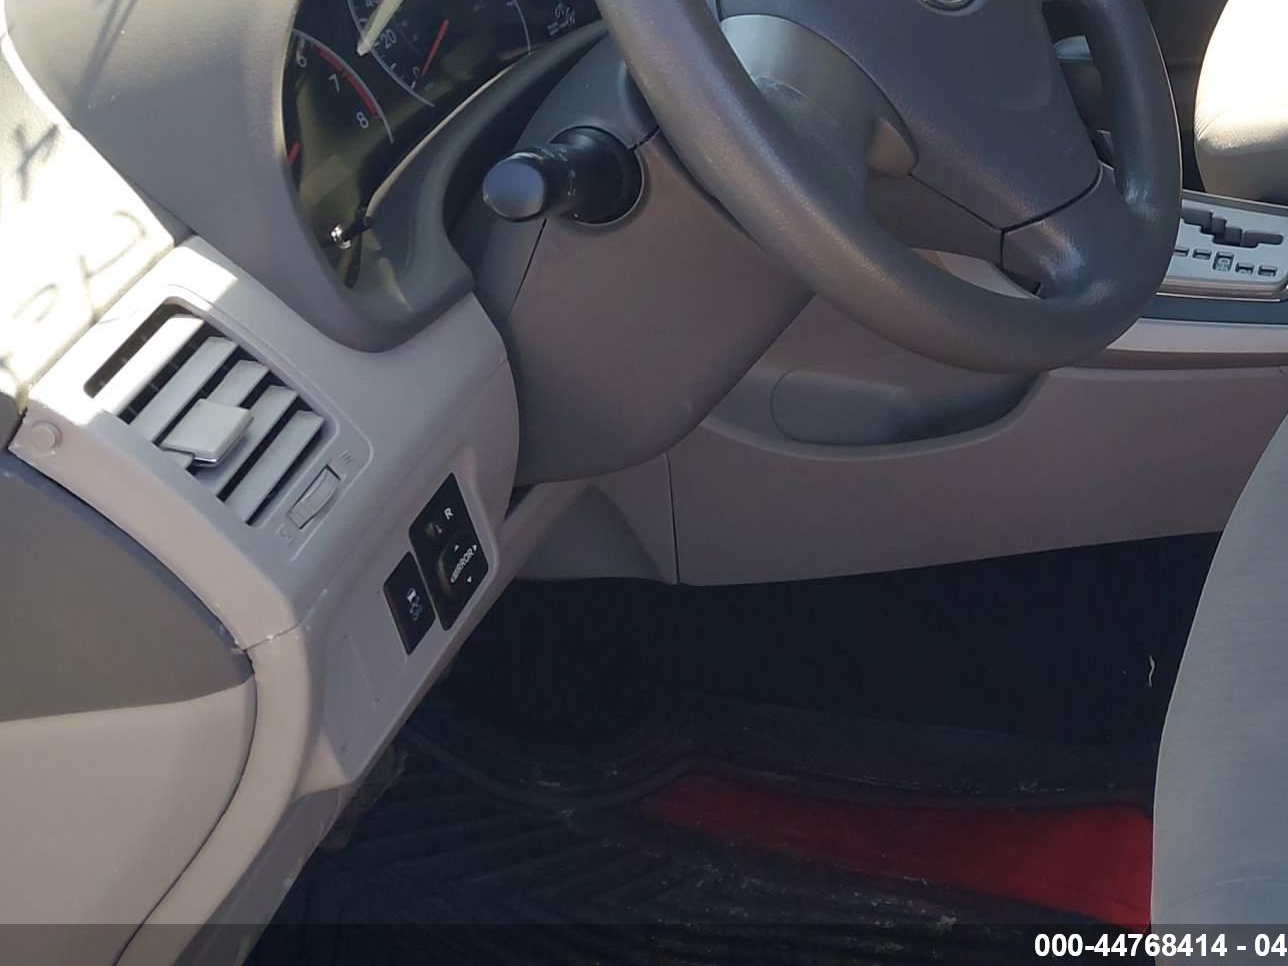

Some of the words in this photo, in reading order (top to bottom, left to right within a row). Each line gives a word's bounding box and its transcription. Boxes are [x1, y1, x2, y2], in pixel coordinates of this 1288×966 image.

[380, 29, 398, 49] 20
[328, 73, 340, 92] 7
[356, 111, 369, 129] 8
[444, 507, 454, 520] R
